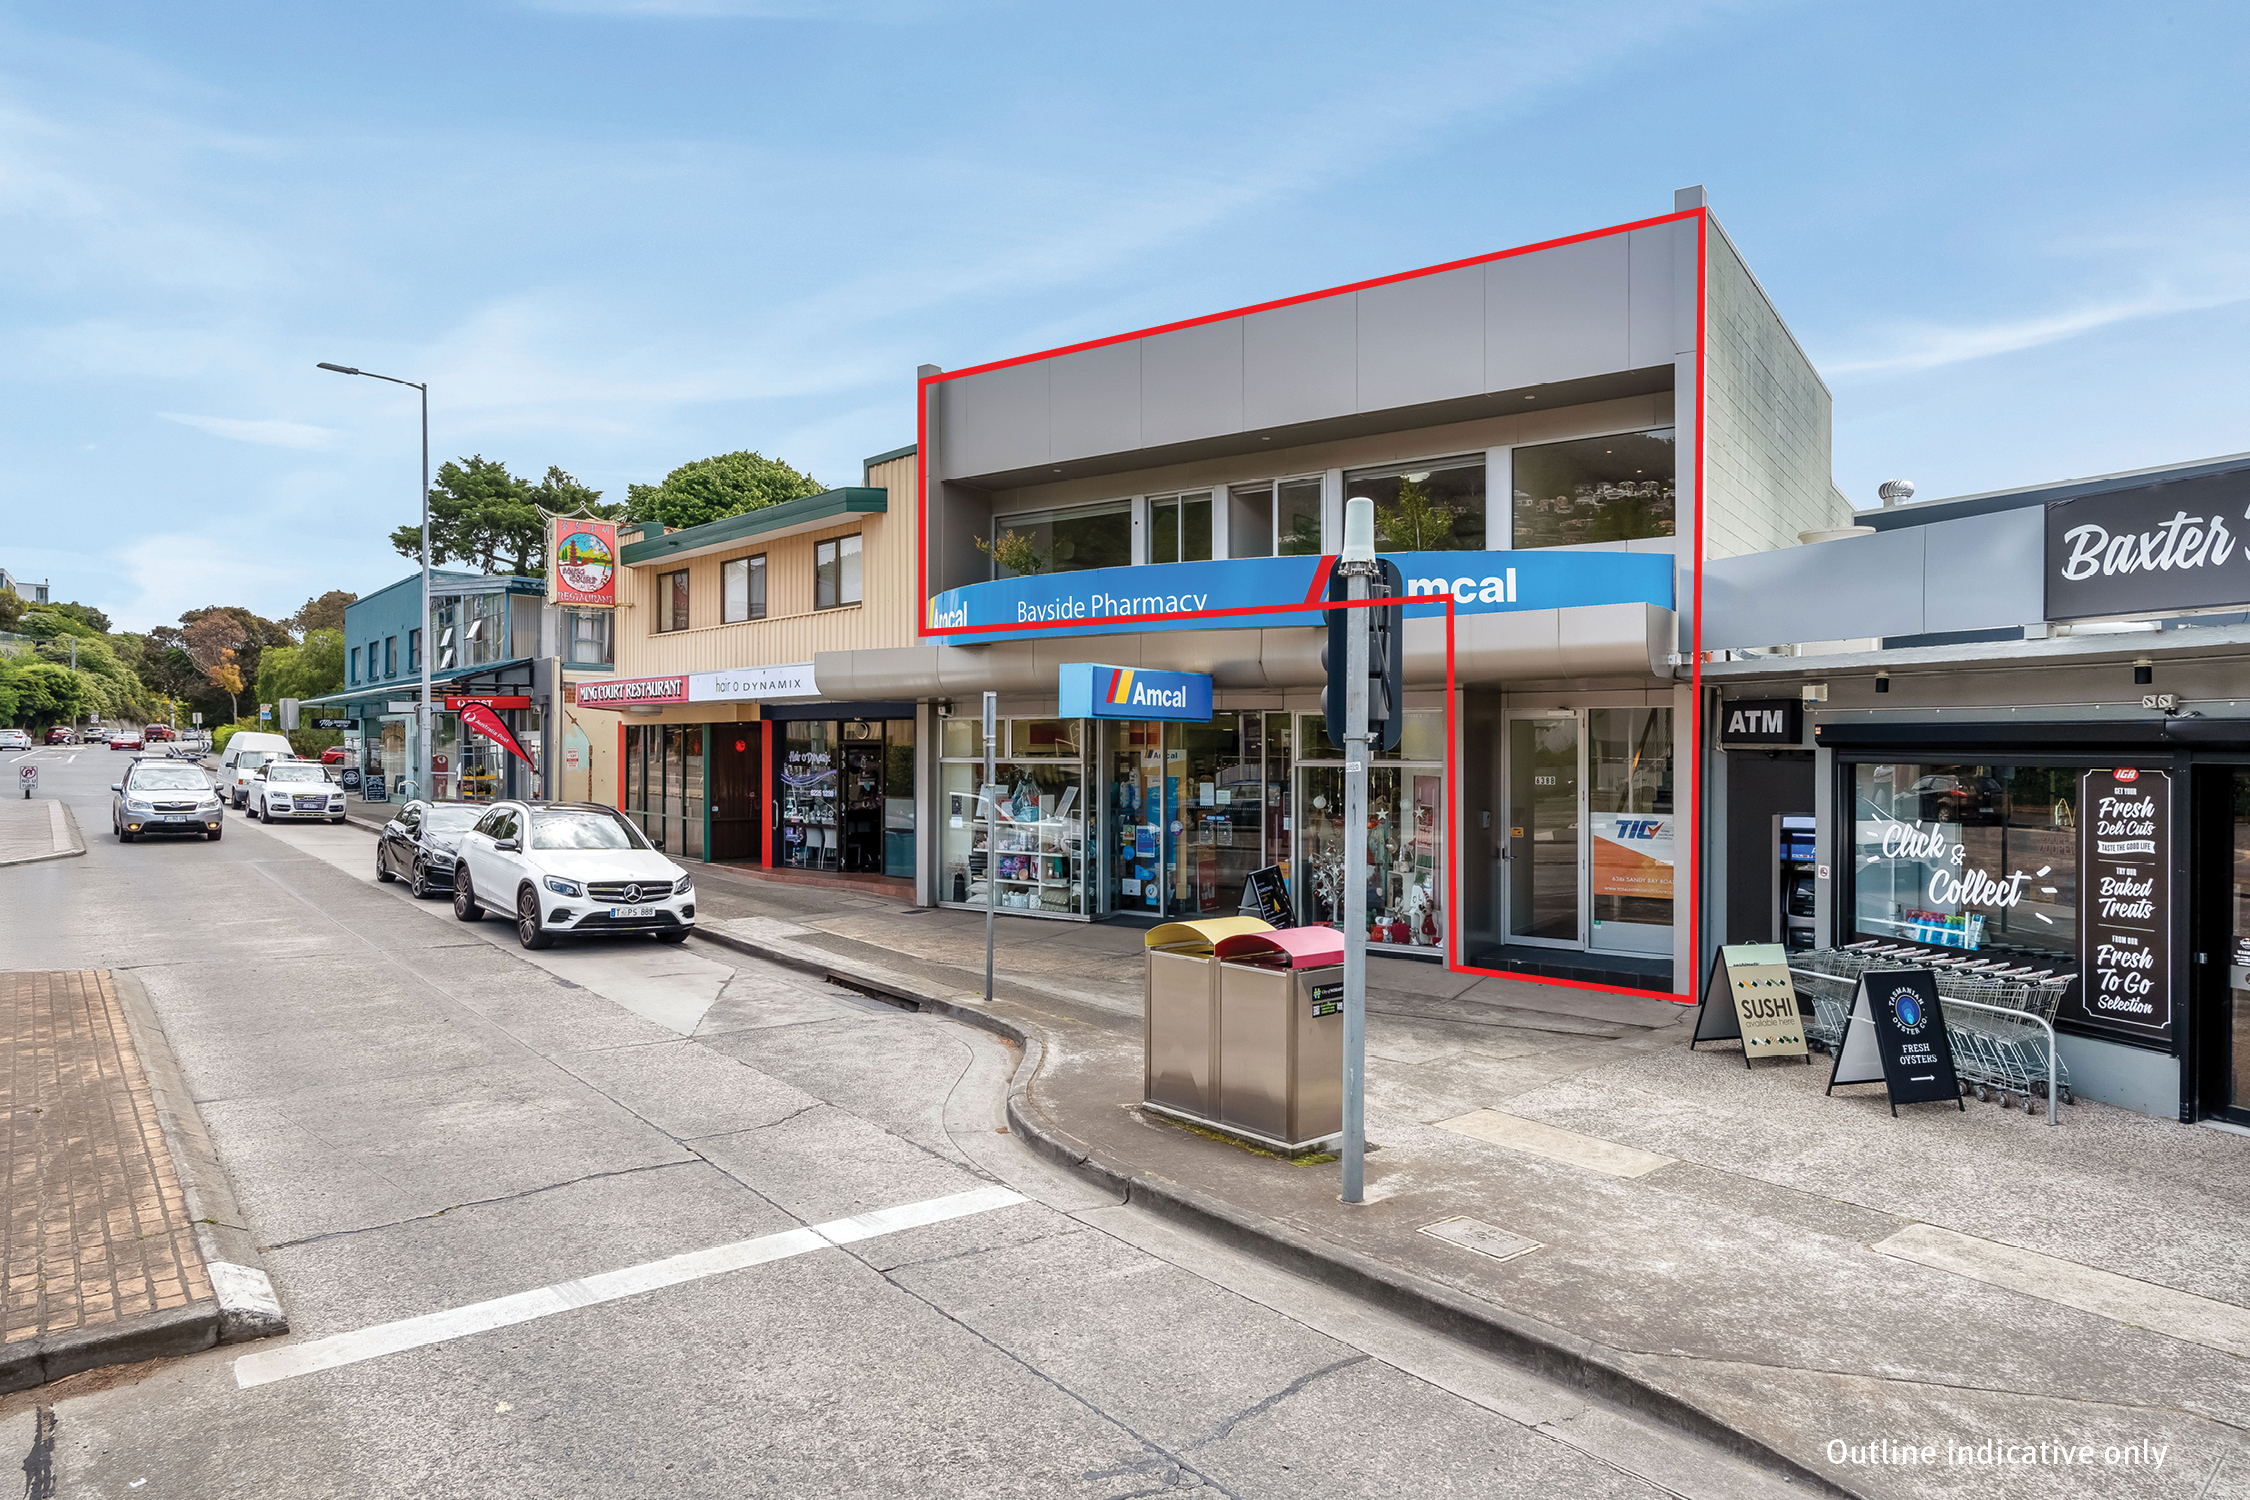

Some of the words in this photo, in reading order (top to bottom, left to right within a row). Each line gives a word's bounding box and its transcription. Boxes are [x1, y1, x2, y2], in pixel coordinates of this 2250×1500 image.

[2061, 510, 2237, 581] Baxter
[1407, 567, 1517, 605] mcal
[557, 591, 613, 604] RESTAURANT
[1017, 596, 1086, 623] Bayside
[1091, 592, 1208, 619] Pharmacy
[579, 685, 598, 701] MING
[597, 682, 624, 700] COURT
[625, 678, 683, 699] RESTAURANT
[715, 677, 731, 693] hair
[743, 678, 801, 692] DYNAMIX
[1132, 681, 1186, 708] Amcal
[474, 719, 498, 736] Australia
[496, 732, 510, 744] Post
[1728, 710, 1783, 733] ATM
[2115, 769, 2137, 779] IGA
[2098, 795, 2155, 819] Fresh
[1615, 819, 1660, 840] TIC
[1881, 819, 1947, 858] Click
[2097, 819, 2127, 836] Deli
[2126, 820, 2156, 836] Cuts
[1950, 844, 1967, 866] &
[2101, 842, 2116, 852] TASTE
[2116, 843, 2126, 851] THE
[2126, 842, 2140, 850] GOOD
[2140, 842, 2151, 850] LIFE
[1928, 868, 2033, 907] Collect
[2099, 877, 2154, 897] Baked
[2098, 897, 2156, 919] Treats
[2096, 944, 2154, 969] Fresh
[2096, 968, 2124, 991] To
[2123, 971, 2155, 995] Go
[1888, 986, 1925, 1007] TASMANIAN
[2097, 994, 2154, 1014] Selection
[1741, 997, 1794, 1020] SUSHI
[1745, 1018, 1778, 1028] available
[1778, 1018, 1796, 1026] here
[1892, 1016, 1920, 1035] OYSTER
[1899, 1053, 1938, 1066] OYSTERS
[1902, 1043, 1931, 1054] FRESH
